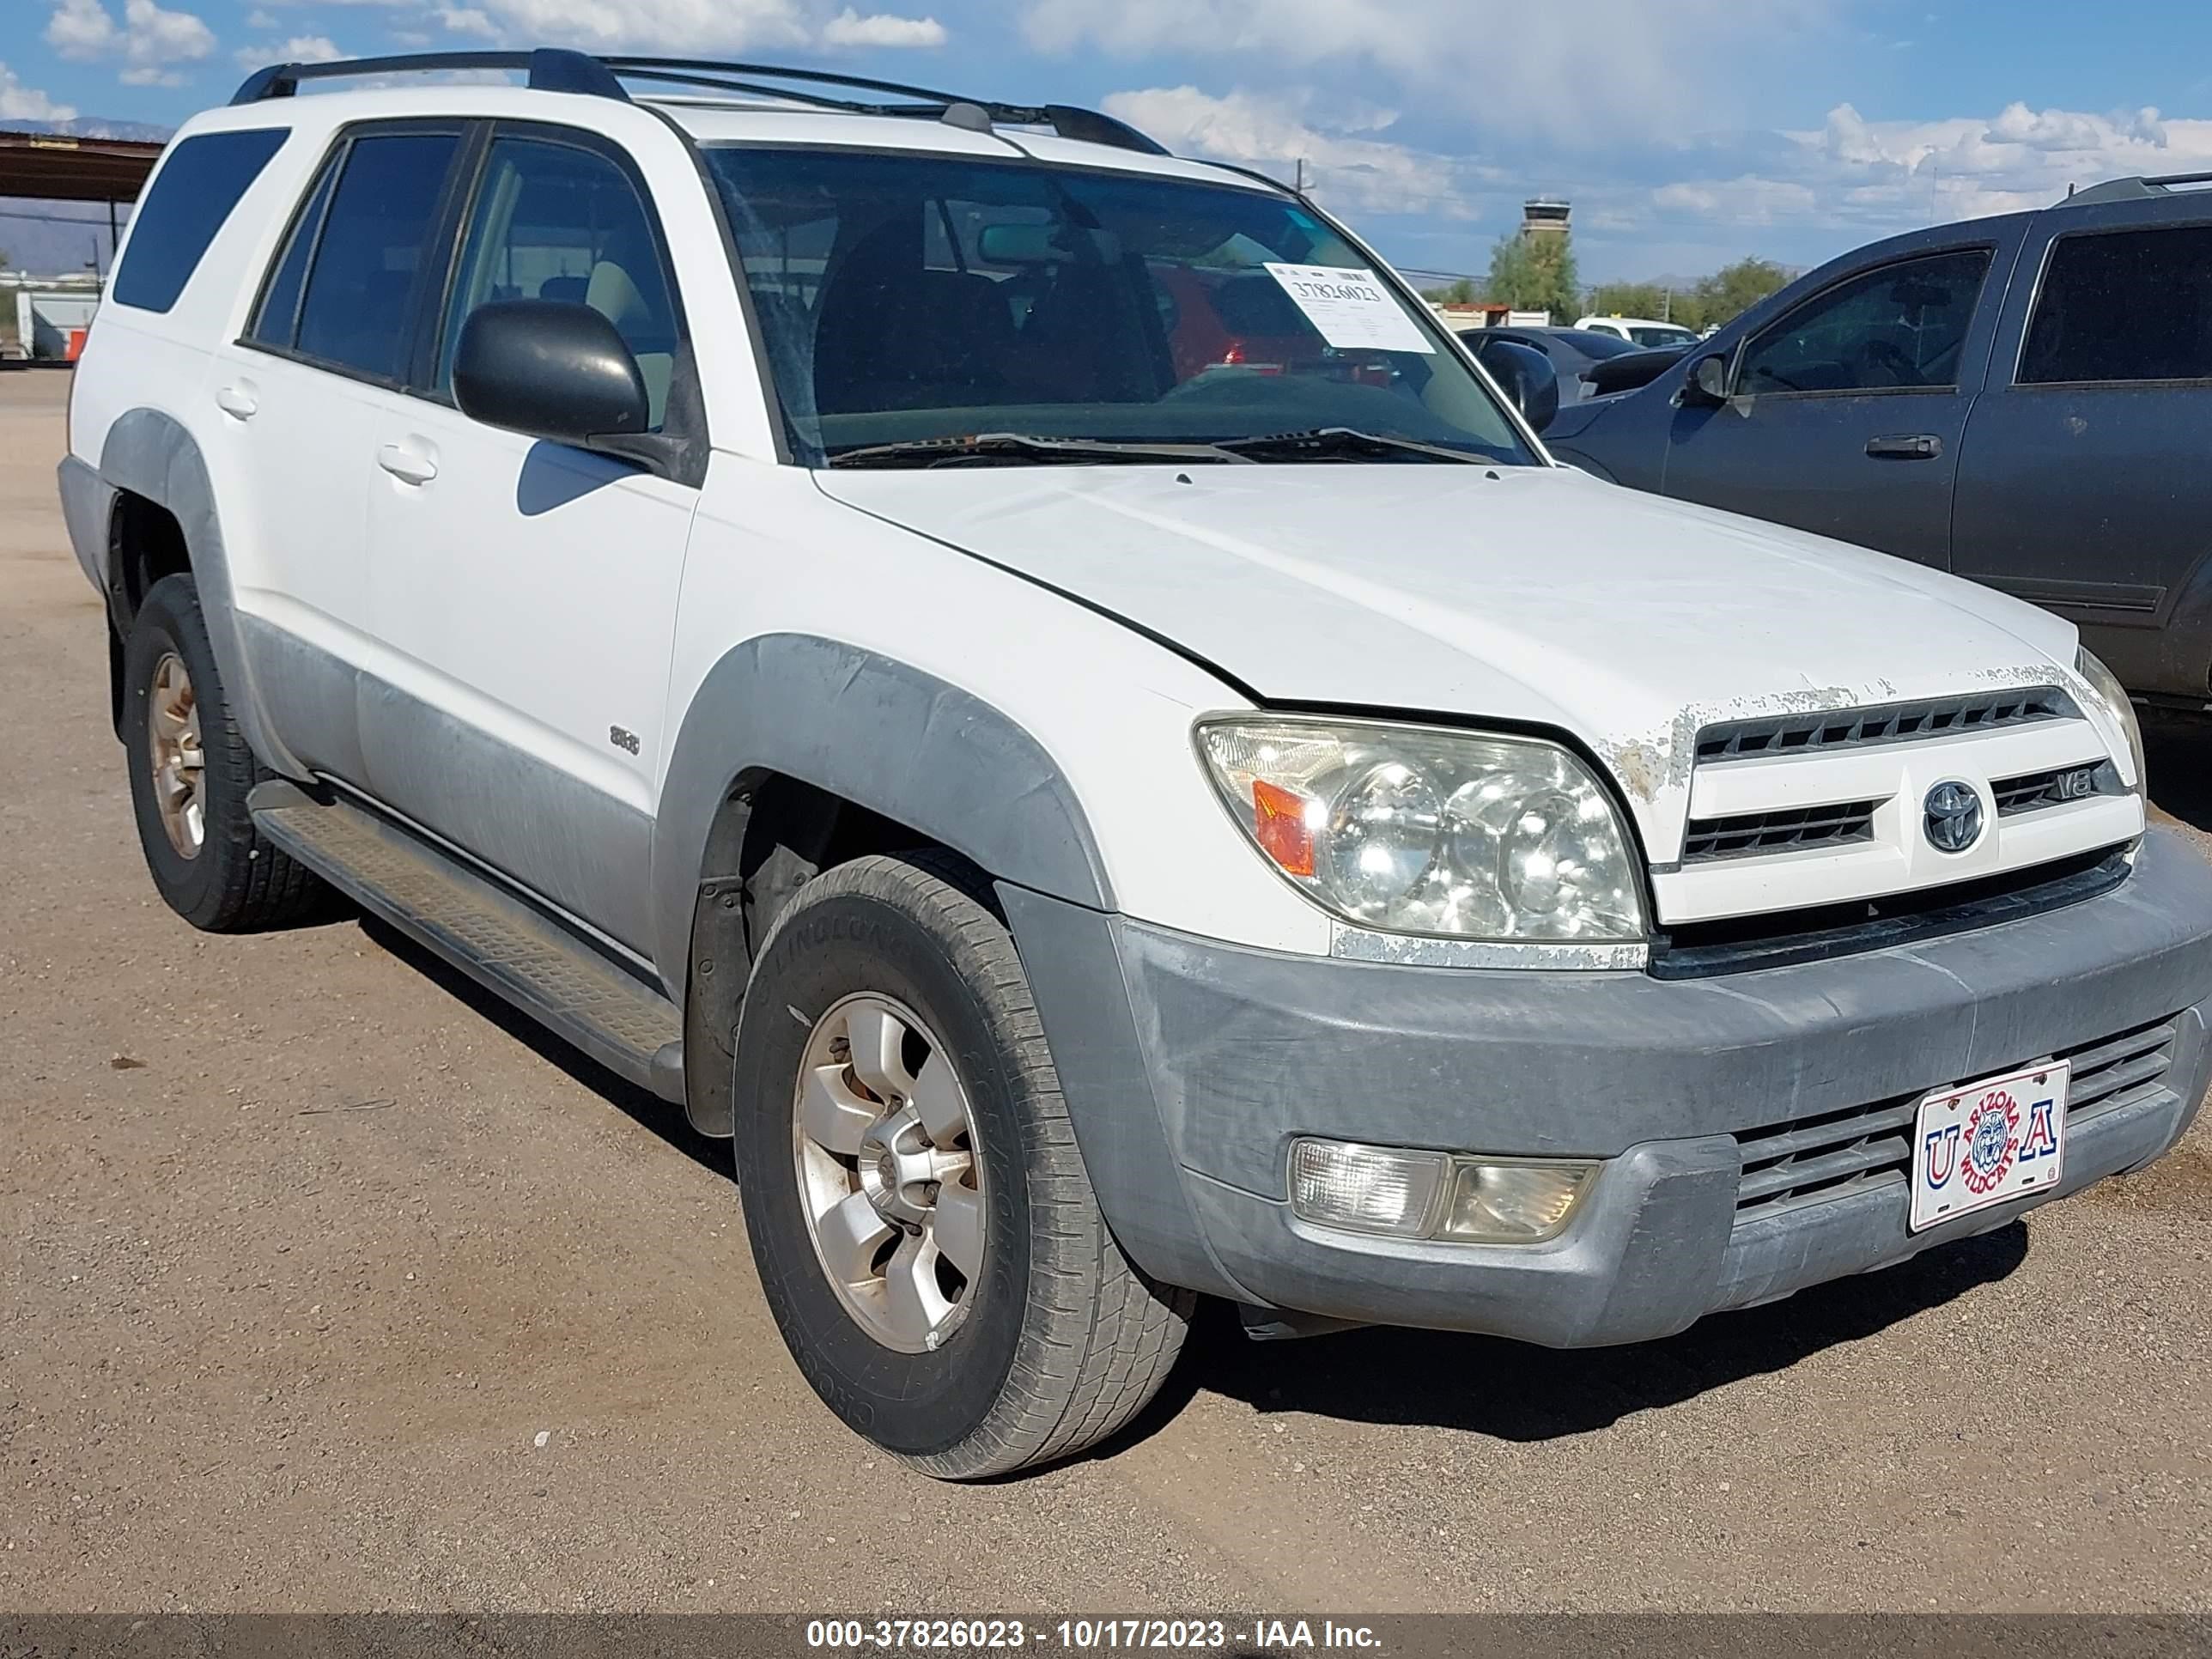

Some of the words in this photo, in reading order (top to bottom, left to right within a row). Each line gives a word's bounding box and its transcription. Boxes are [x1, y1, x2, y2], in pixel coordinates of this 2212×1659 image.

[1291, 282, 1381, 303] 37826023
[1924, 1124, 1960, 1190] U
[2019, 1098, 2057, 1163] A
[1963, 1091, 2021, 1144] ARIZONA
[1960, 1137, 2020, 1194] WILDCATS
